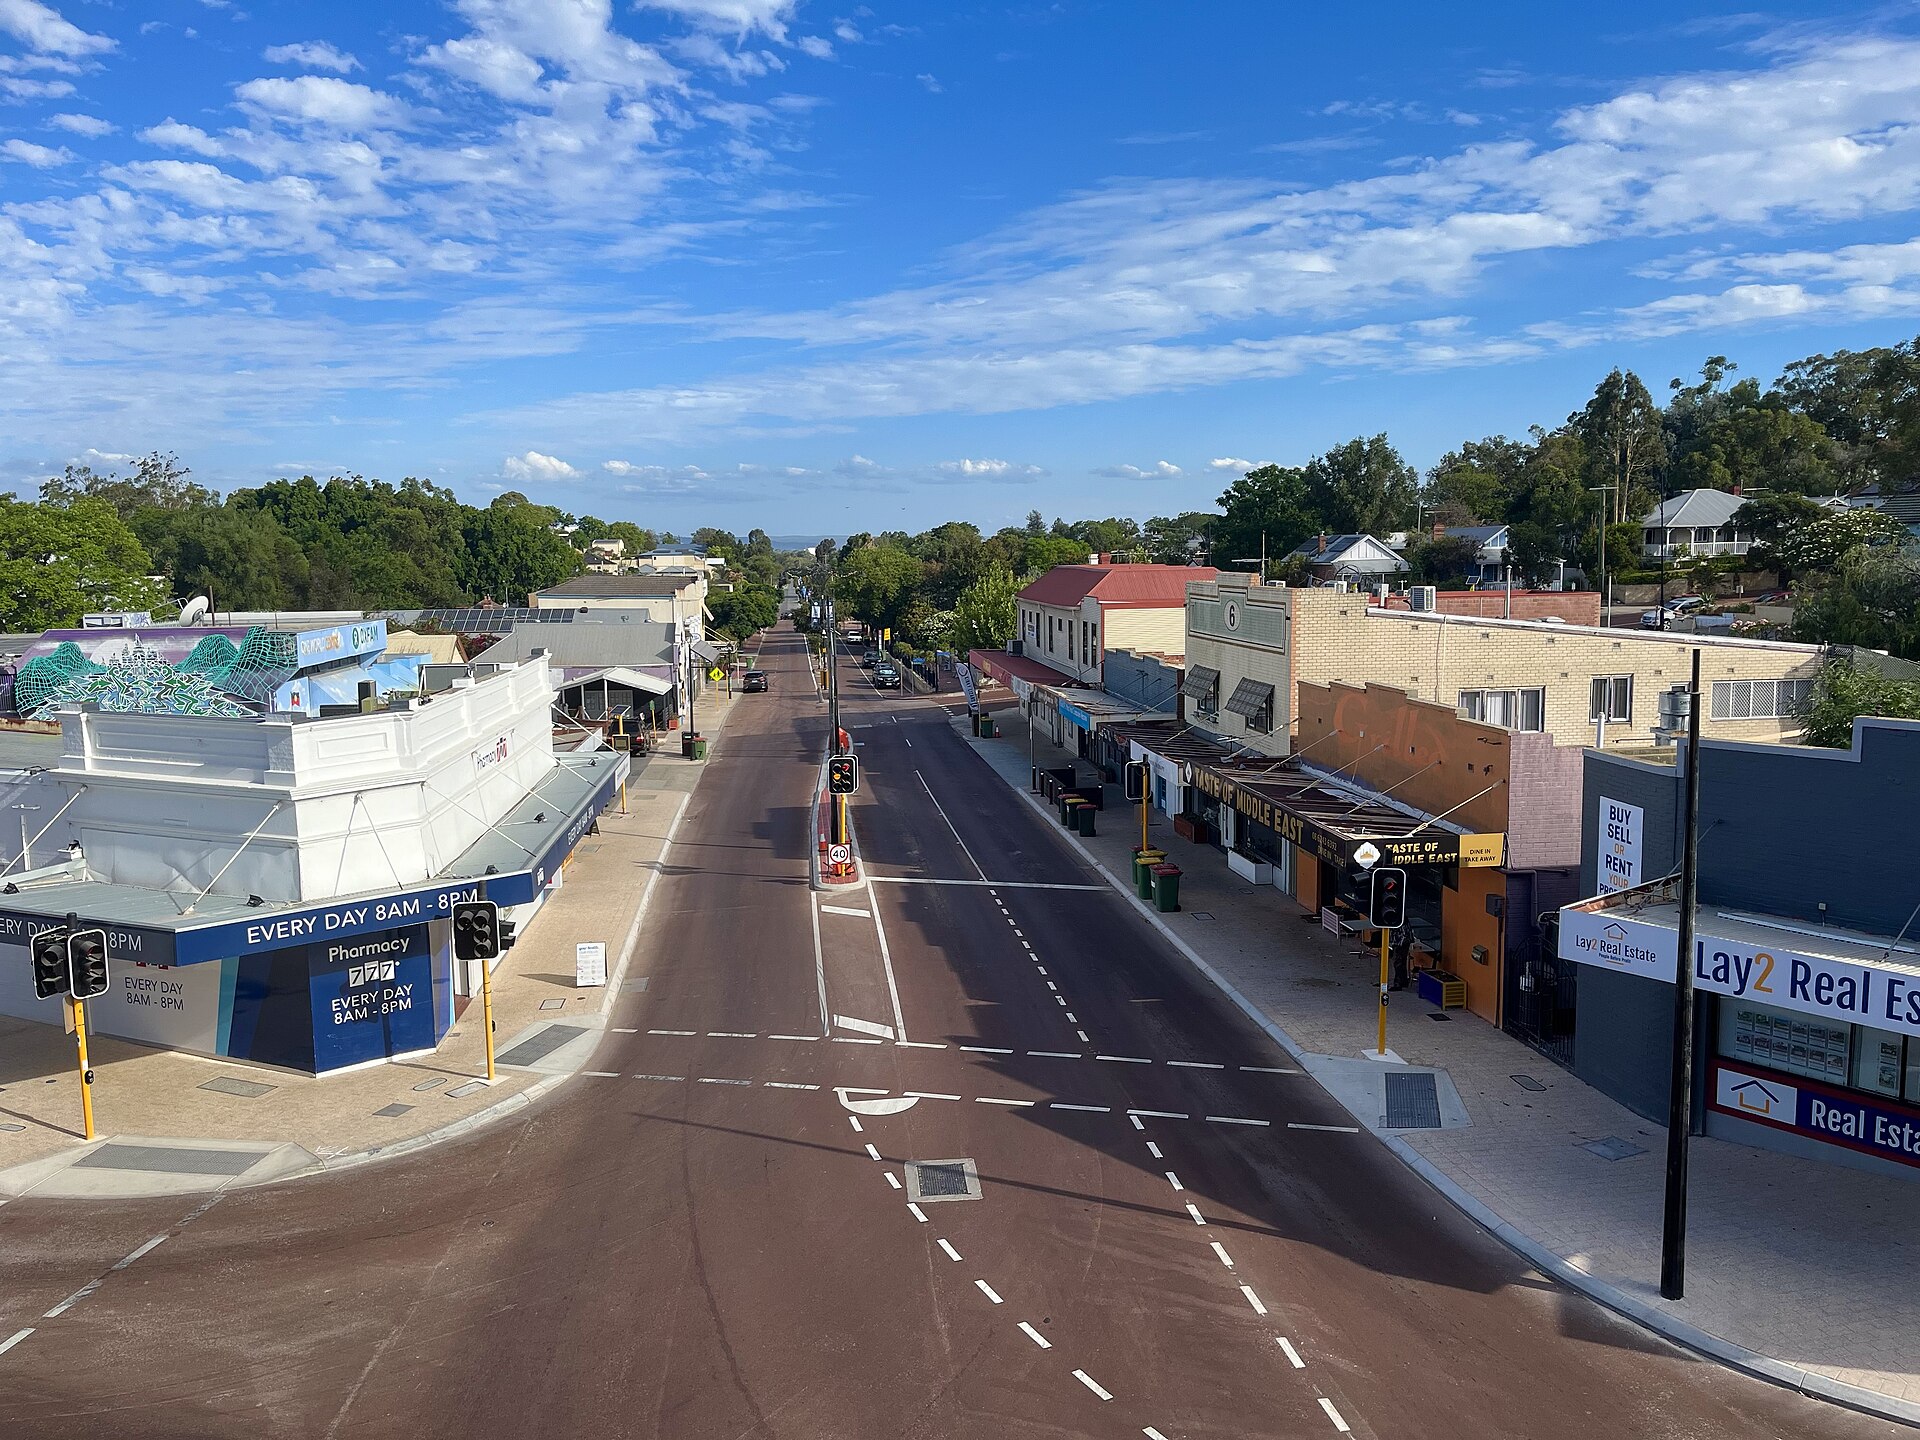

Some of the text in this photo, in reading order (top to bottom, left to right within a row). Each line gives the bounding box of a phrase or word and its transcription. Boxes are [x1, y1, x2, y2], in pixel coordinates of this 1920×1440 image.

[1229, 604, 1235, 627] 6
[360, 626, 379, 644] OXFAM
[1194, 766, 1304, 844] TASTE OF MIDDLE EAST
[1609, 805, 1632, 825] BUY
[1607, 823, 1632, 845] SELL
[832, 849, 846, 859] 40
[1424, 842, 1439, 852] OF
[1614, 843, 1625, 856] OR
[1393, 852, 1458, 865] IDDLE EAST
[1605, 854, 1633, 877] RENT
[1608, 873, 1629, 889] YOUR
[246, 915, 317, 944] EVERY
[324, 907, 369, 930] DAY
[375, 898, 420, 921] 8AM
[438, 888, 478, 910] 8PM
[109, 931, 142, 951] 8PM
[328, 937, 410, 963] Pharmacy
[1575, 934, 1656, 962] Lay2 Real Estate
[350, 961, 394, 986] 777
[1696, 940, 1775, 996] Lay2
[1790, 958, 1871, 1015] Real
[124, 976, 184, 995] EVERY DAY
[126, 992, 151, 1006] 8AM
[160, 996, 184, 1010] 8PM
[331, 983, 413, 1012] EVERY DAY
[334, 1007, 368, 1025] 8AM
[381, 997, 412, 1014] 8PM
[1811, 1099, 1865, 1139] Real
